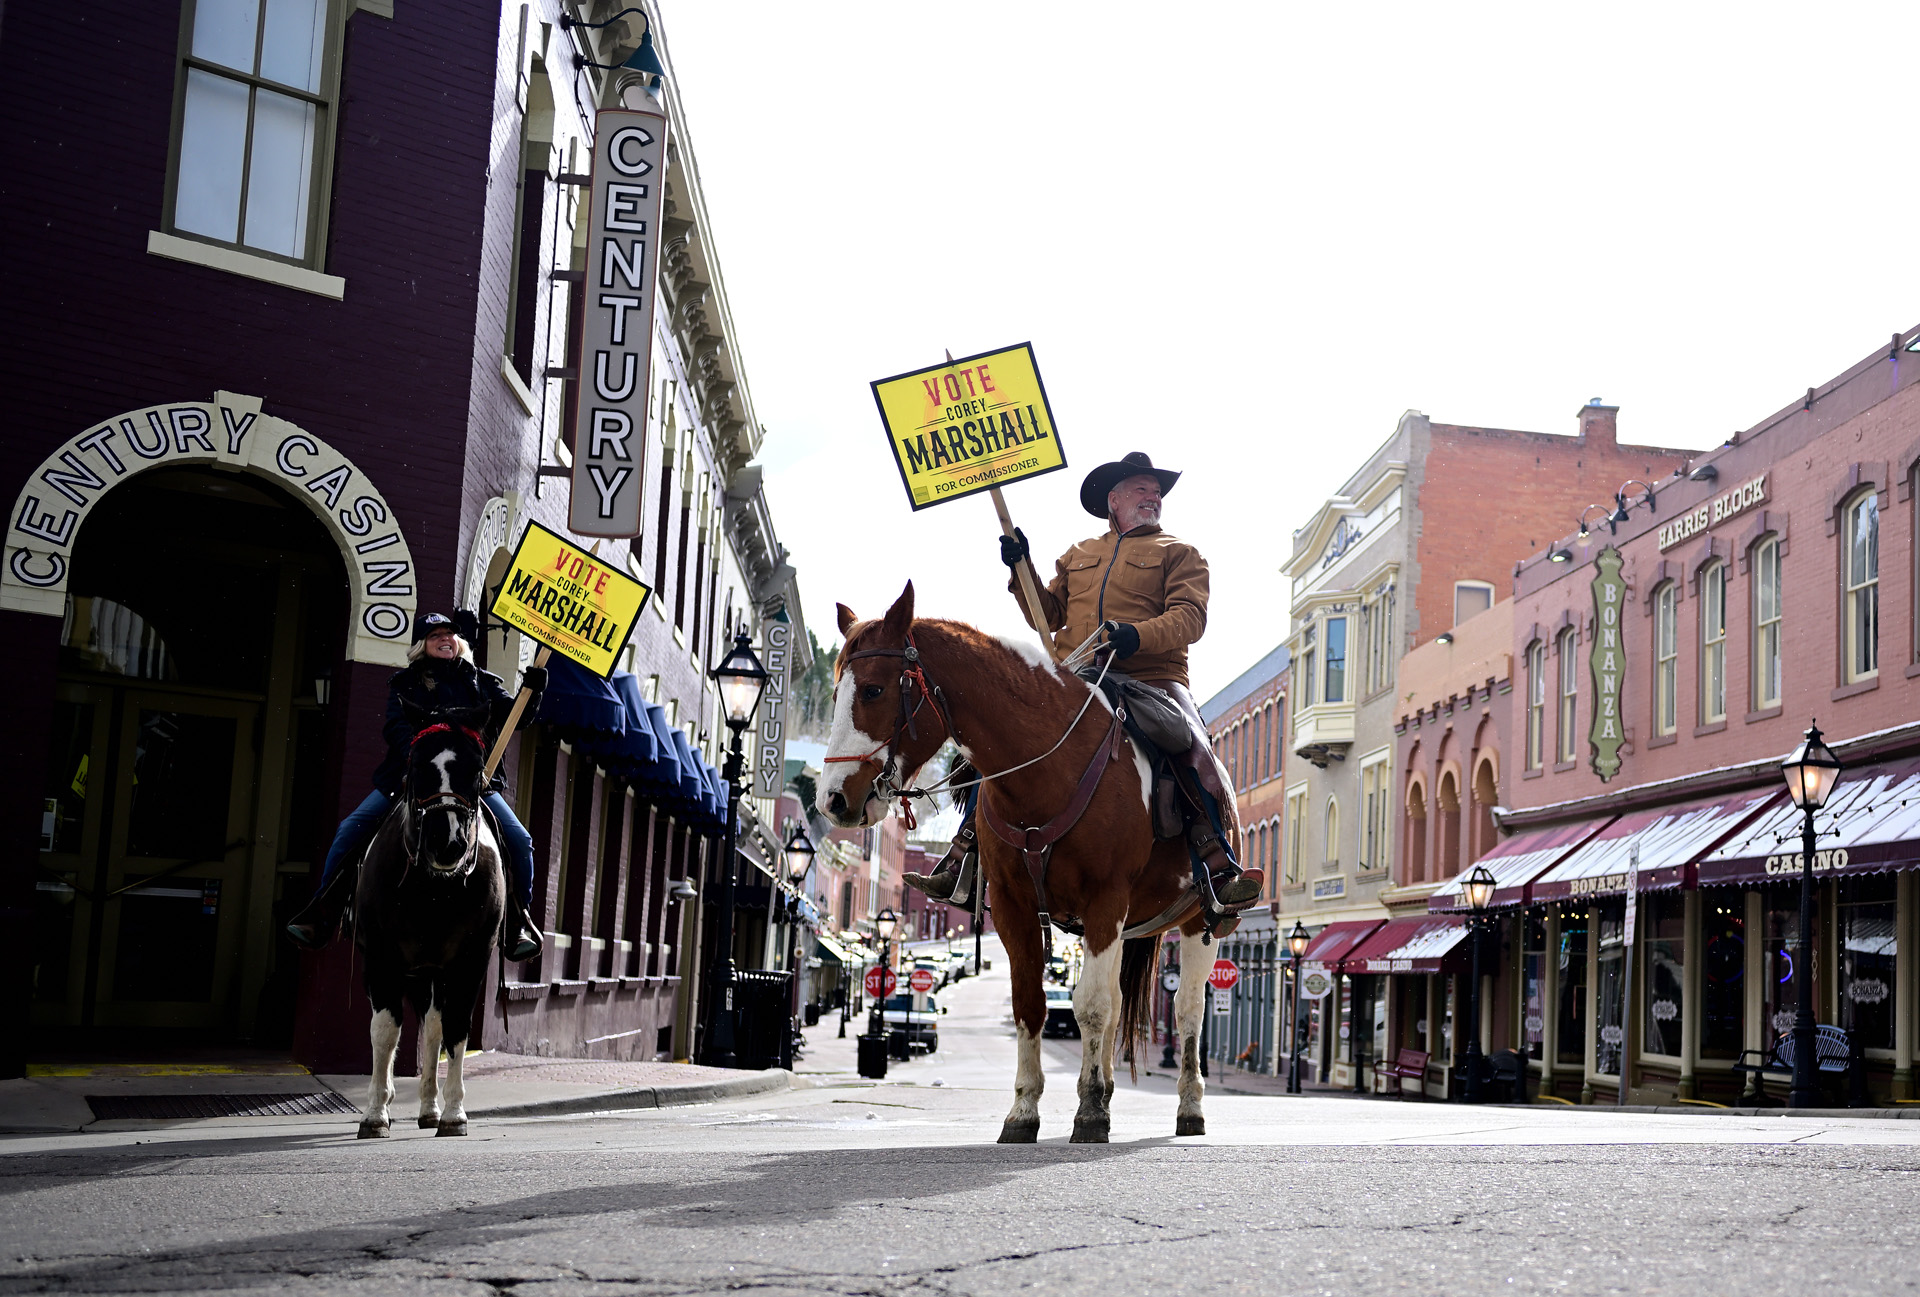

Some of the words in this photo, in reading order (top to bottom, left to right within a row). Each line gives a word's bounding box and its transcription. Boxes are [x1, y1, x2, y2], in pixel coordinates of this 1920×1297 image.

[588, 126, 655, 519] CENTURY
[922, 364, 996, 407] VOTE
[946, 398, 988, 421] COREY
[901, 404, 1048, 475] MARSHALL
[935, 480, 958, 494] FOR
[958, 457, 1040, 488] COMMISSIONER
[9, 406, 259, 588] CENTURY
[275, 435, 412, 639] CASINO
[1658, 504, 1711, 551] HARRIS
[1713, 475, 1766, 523] BLOCK
[555, 547, 611, 595] VOTE
[556, 576, 590, 602] COREY
[506, 567, 619, 653] MARSHALL
[510, 611, 527, 627] FOR
[527, 622, 592, 664] COMMISSIONER
[1601, 583, 1617, 738] BONANZA
[760, 624, 788, 793] CENTURY
[866, 975, 895, 989] STP
[1210, 968, 1236, 981] STOP
